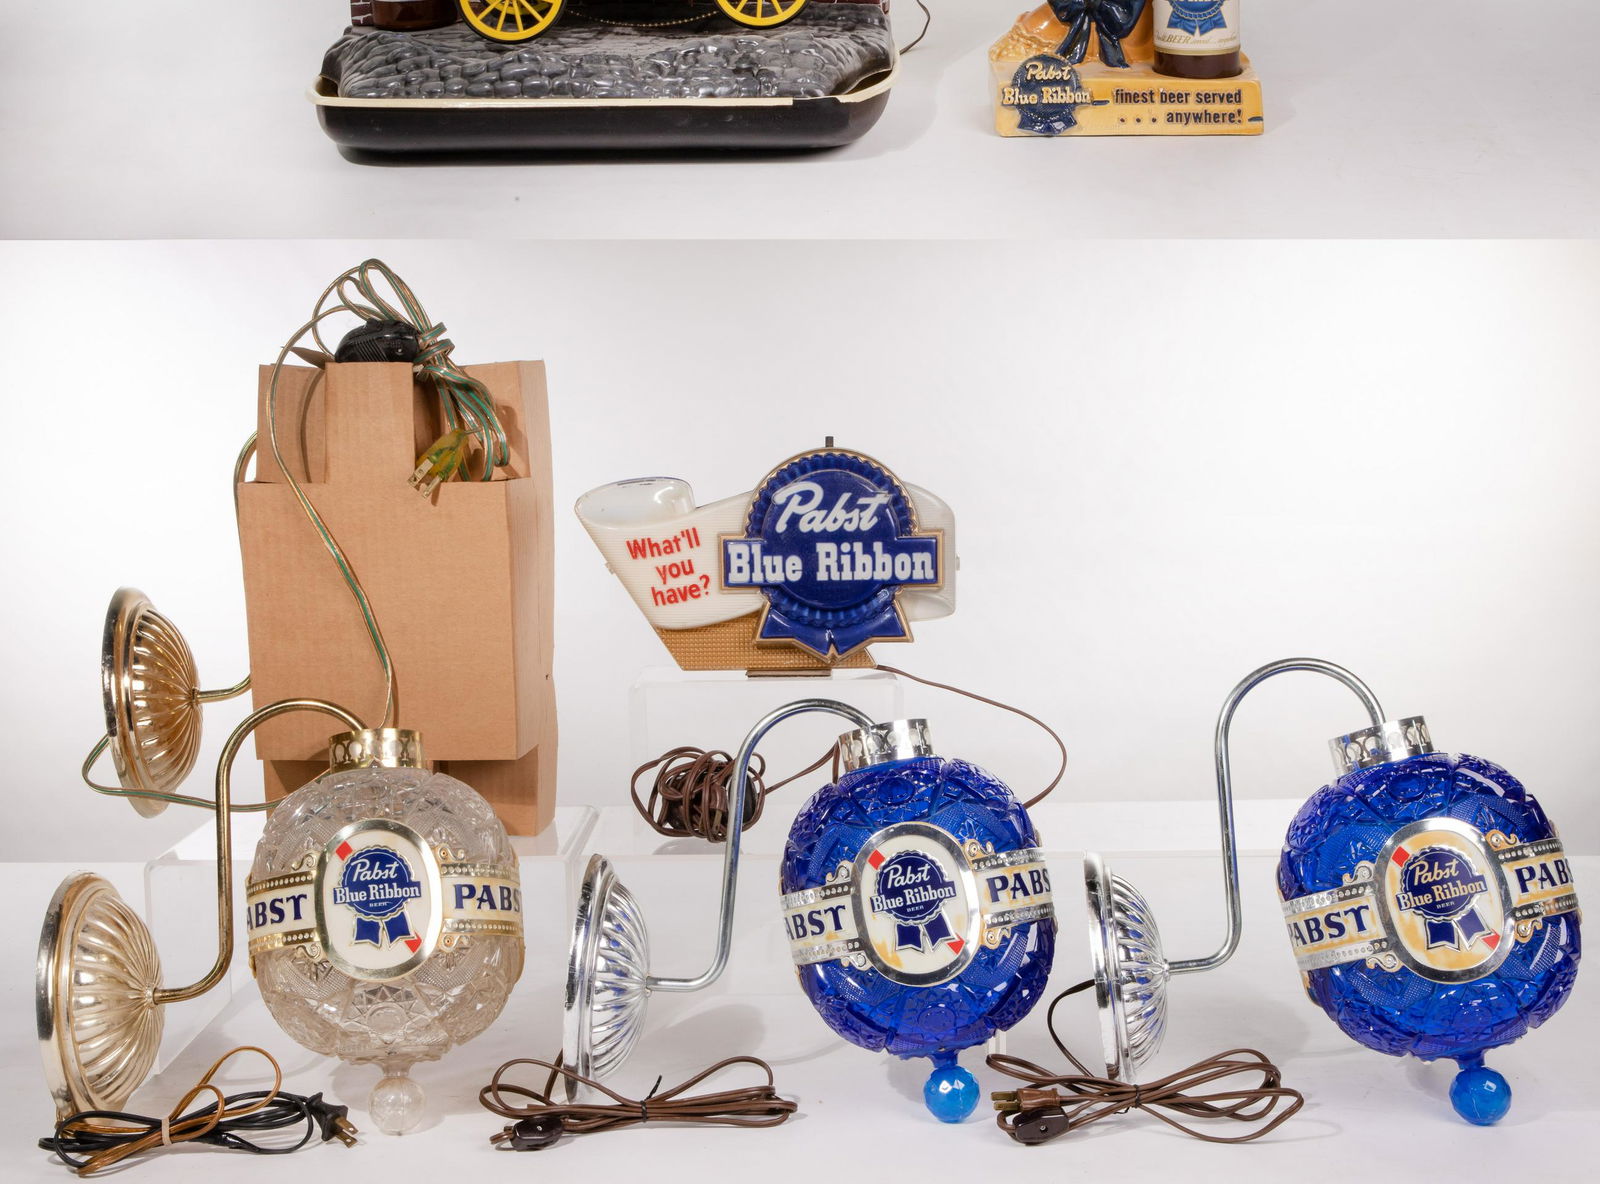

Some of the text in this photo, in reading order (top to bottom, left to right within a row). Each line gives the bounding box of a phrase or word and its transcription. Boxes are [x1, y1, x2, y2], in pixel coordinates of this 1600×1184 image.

[1026, 61, 1071, 81] Pabst
[1003, 86, 1091, 104] Blue Ribbon
[1114, 88, 1242, 104] finest beer served
[1166, 108, 1242, 125] anywhere!
[772, 481, 889, 533] Pabst
[626, 527, 701, 560] What'll
[655, 559, 694, 585] you
[728, 542, 934, 584] Blue Ribbon
[651, 574, 710, 606] have?
[351, 858, 399, 882] Pabst
[883, 863, 931, 889] Pabst
[1408, 858, 1459, 886] Pabst
[335, 883, 420, 903] Blue Ribbon
[871, 885, 955, 912] Blue Ribbon
[1397, 880, 1487, 910] Blue Ribbon
